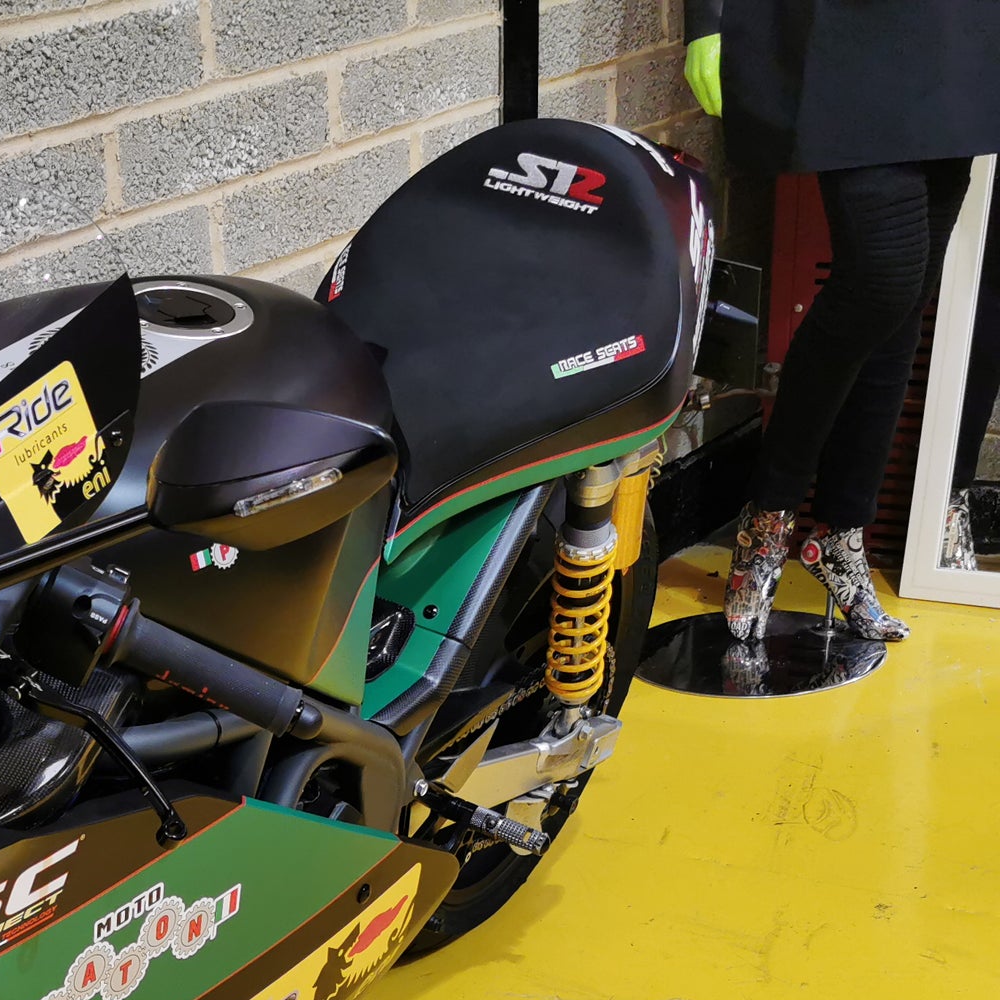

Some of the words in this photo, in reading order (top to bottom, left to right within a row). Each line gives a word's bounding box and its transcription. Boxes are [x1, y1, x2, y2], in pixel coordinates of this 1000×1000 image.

[483, 178, 600, 214] LIGHTWEIGHT
[557, 352, 594, 373] RACE
[595, 336, 638, 362] SEATS
[14, 422, 69, 466] lubricants
[82, 460, 111, 500] eni
[2, 904, 58, 940] TECHNOLOGY
[96, 886, 162, 939] MOTO
